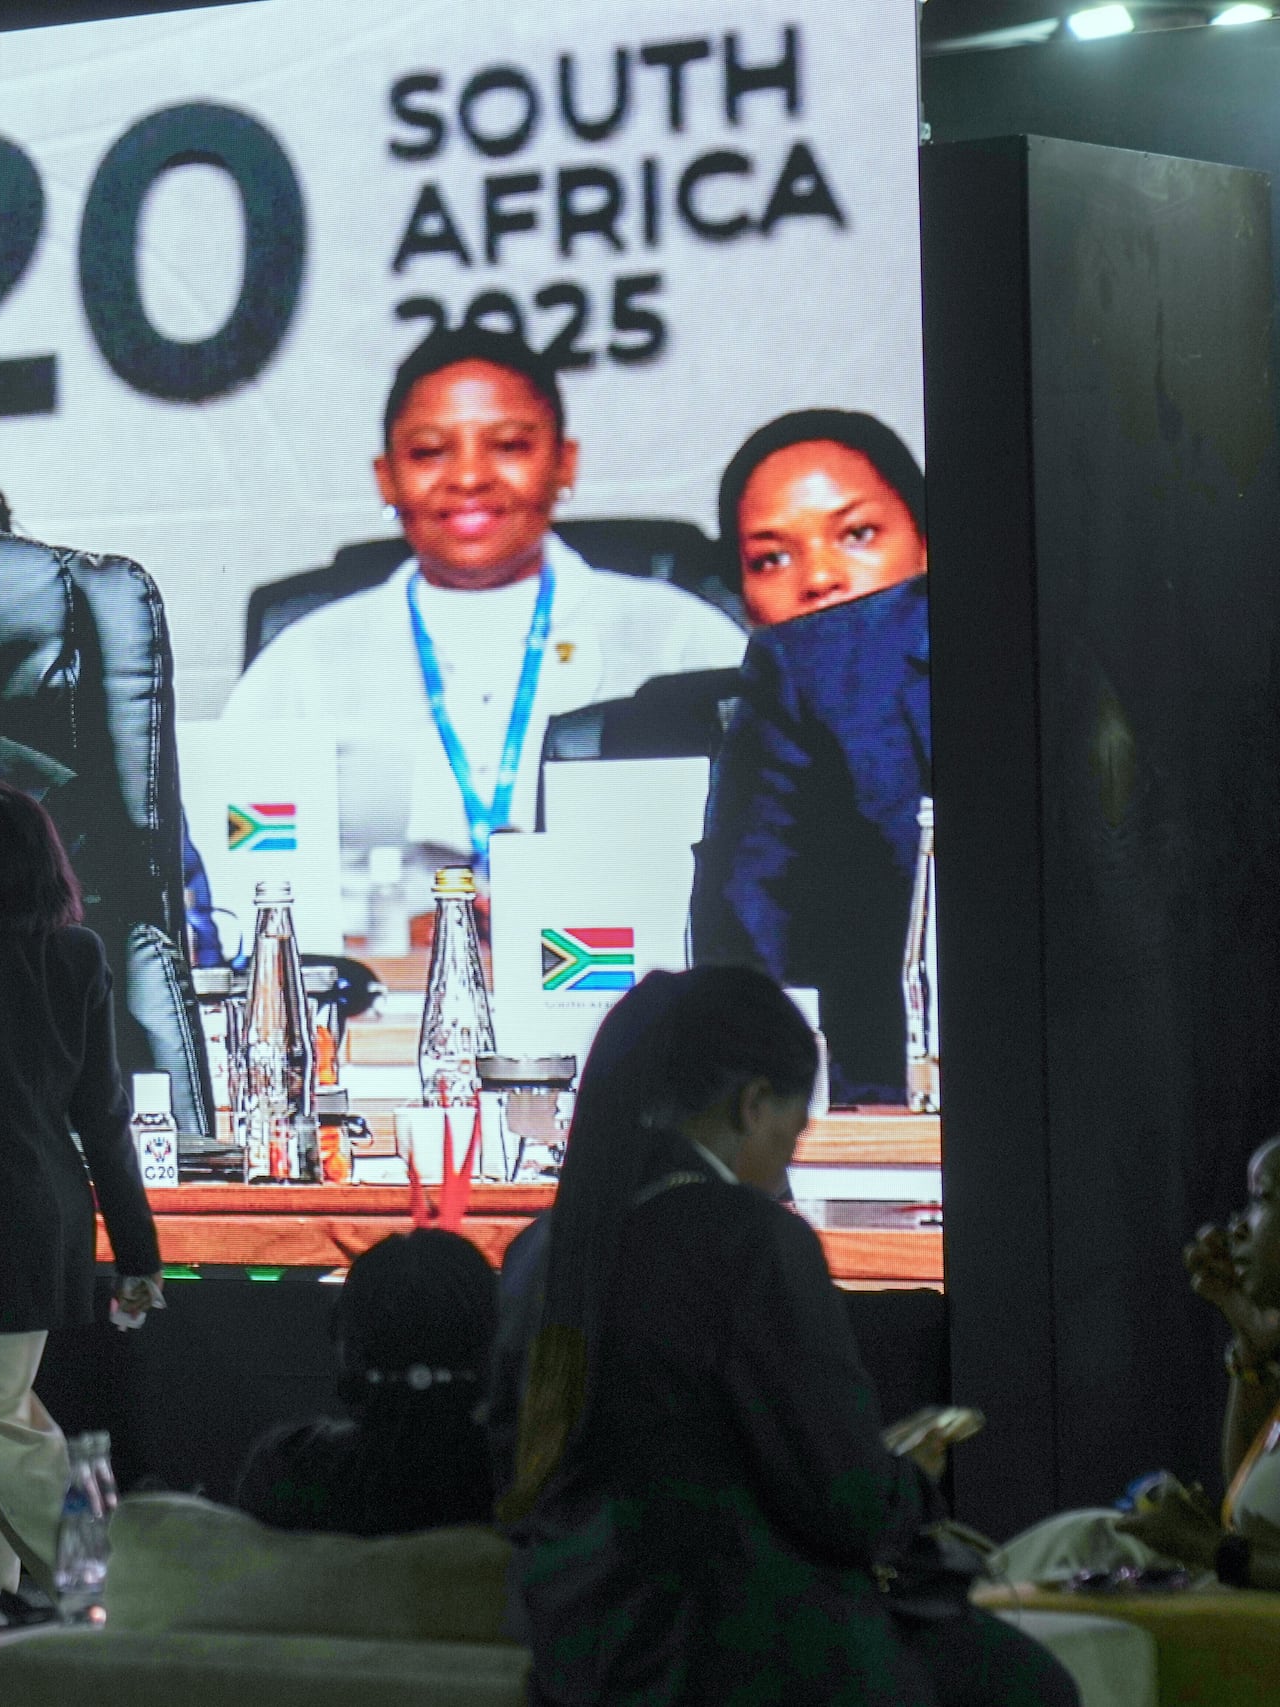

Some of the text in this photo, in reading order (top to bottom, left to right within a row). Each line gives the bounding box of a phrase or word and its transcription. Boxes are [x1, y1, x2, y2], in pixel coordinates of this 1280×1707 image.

[389, 24, 800, 160] SOUTH
[391, 139, 848, 273] AFRICA
[394, 272, 668, 371] 2025
